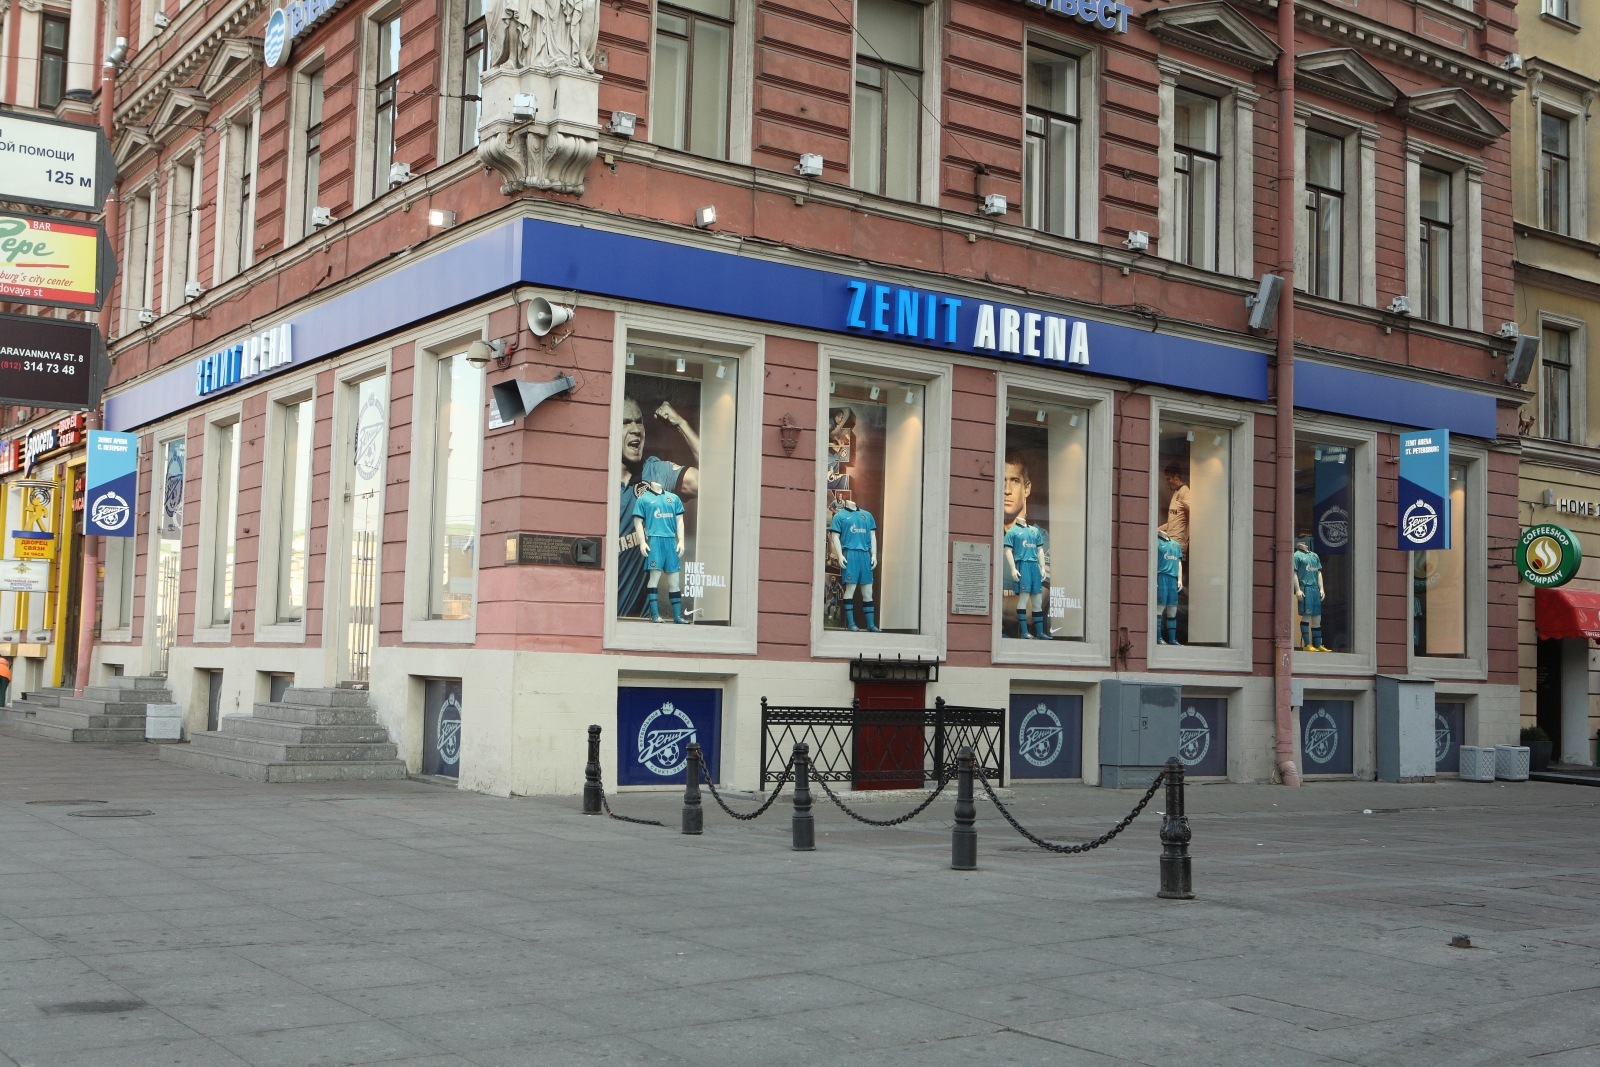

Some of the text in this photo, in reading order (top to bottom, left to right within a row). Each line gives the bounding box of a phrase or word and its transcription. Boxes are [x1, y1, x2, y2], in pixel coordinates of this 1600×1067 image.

[45, 169, 74, 185] 125
[33, 221, 51, 231] BAR
[28, 274, 45, 286] city
[46, 278, 74, 287] center
[33, 288, 43, 297] st
[846, 280, 1090, 365] ZENIT ARENA
[0, 346, 84, 363] ARAVANNAYA ST. 8
[196, 323, 293, 396] ЗЕНИТ АРЕНА
[1, 360, 75, 375] (812) 314 73 48
[1558, 498, 1594, 516] HOME
[1522, 527, 1569, 546] COFFEESHOP
[685, 562, 705, 574] NIKE
[684, 574, 726, 587] FOOTBALL
[1524, 570, 1563, 584] COMPANY
[681, 586, 704, 598] .COM
[1050, 587, 1065, 597] NIKE
[1050, 598, 1082, 608] FOOTBALL
[1048, 608, 1065, 618] .COM
